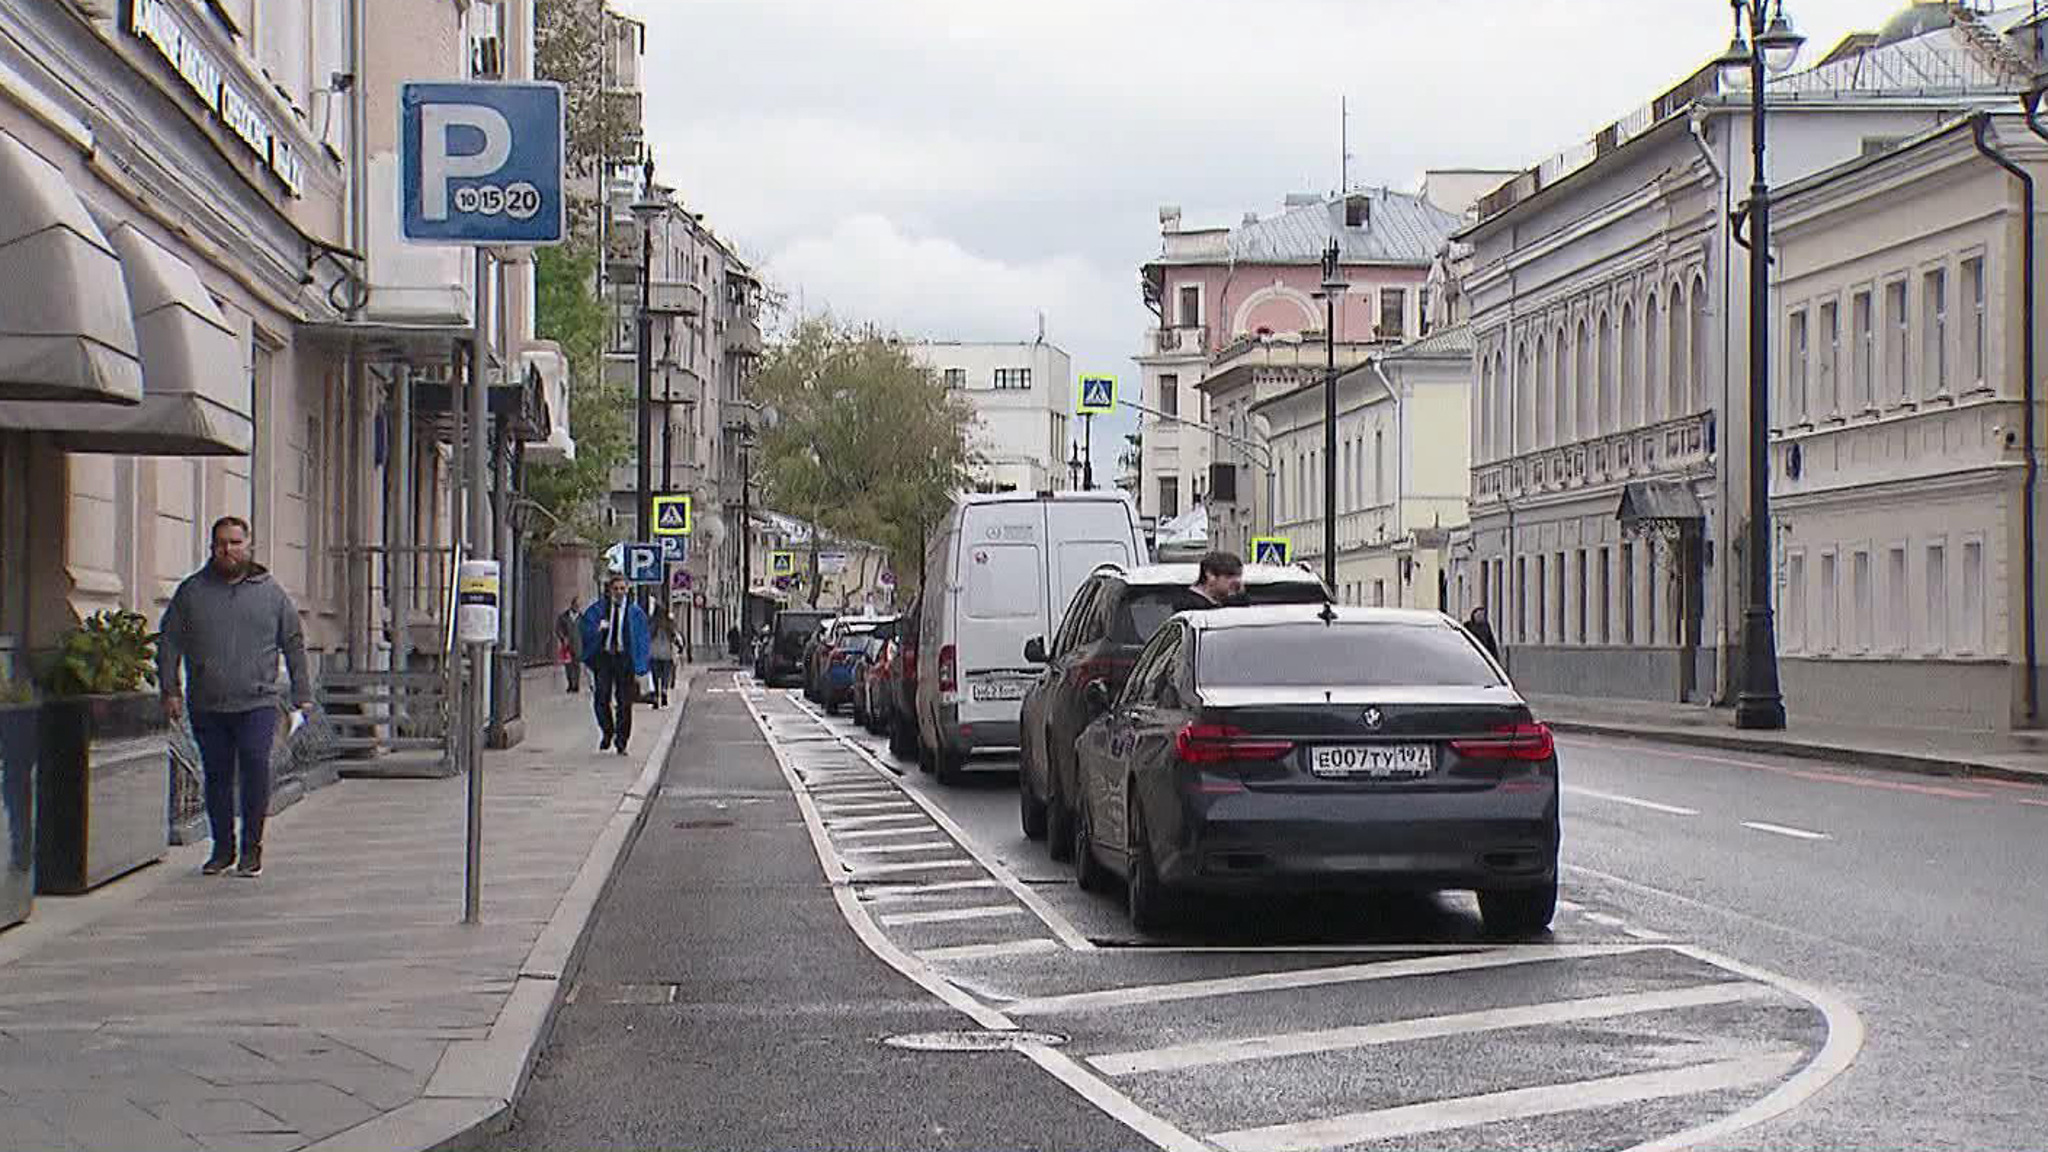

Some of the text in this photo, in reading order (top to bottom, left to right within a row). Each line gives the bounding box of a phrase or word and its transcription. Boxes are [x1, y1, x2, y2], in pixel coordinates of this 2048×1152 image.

[422, 103, 513, 221] P
[460, 191, 537, 210] 10 15 20
[662, 537, 678, 560] P
[630, 549, 655, 579] P
